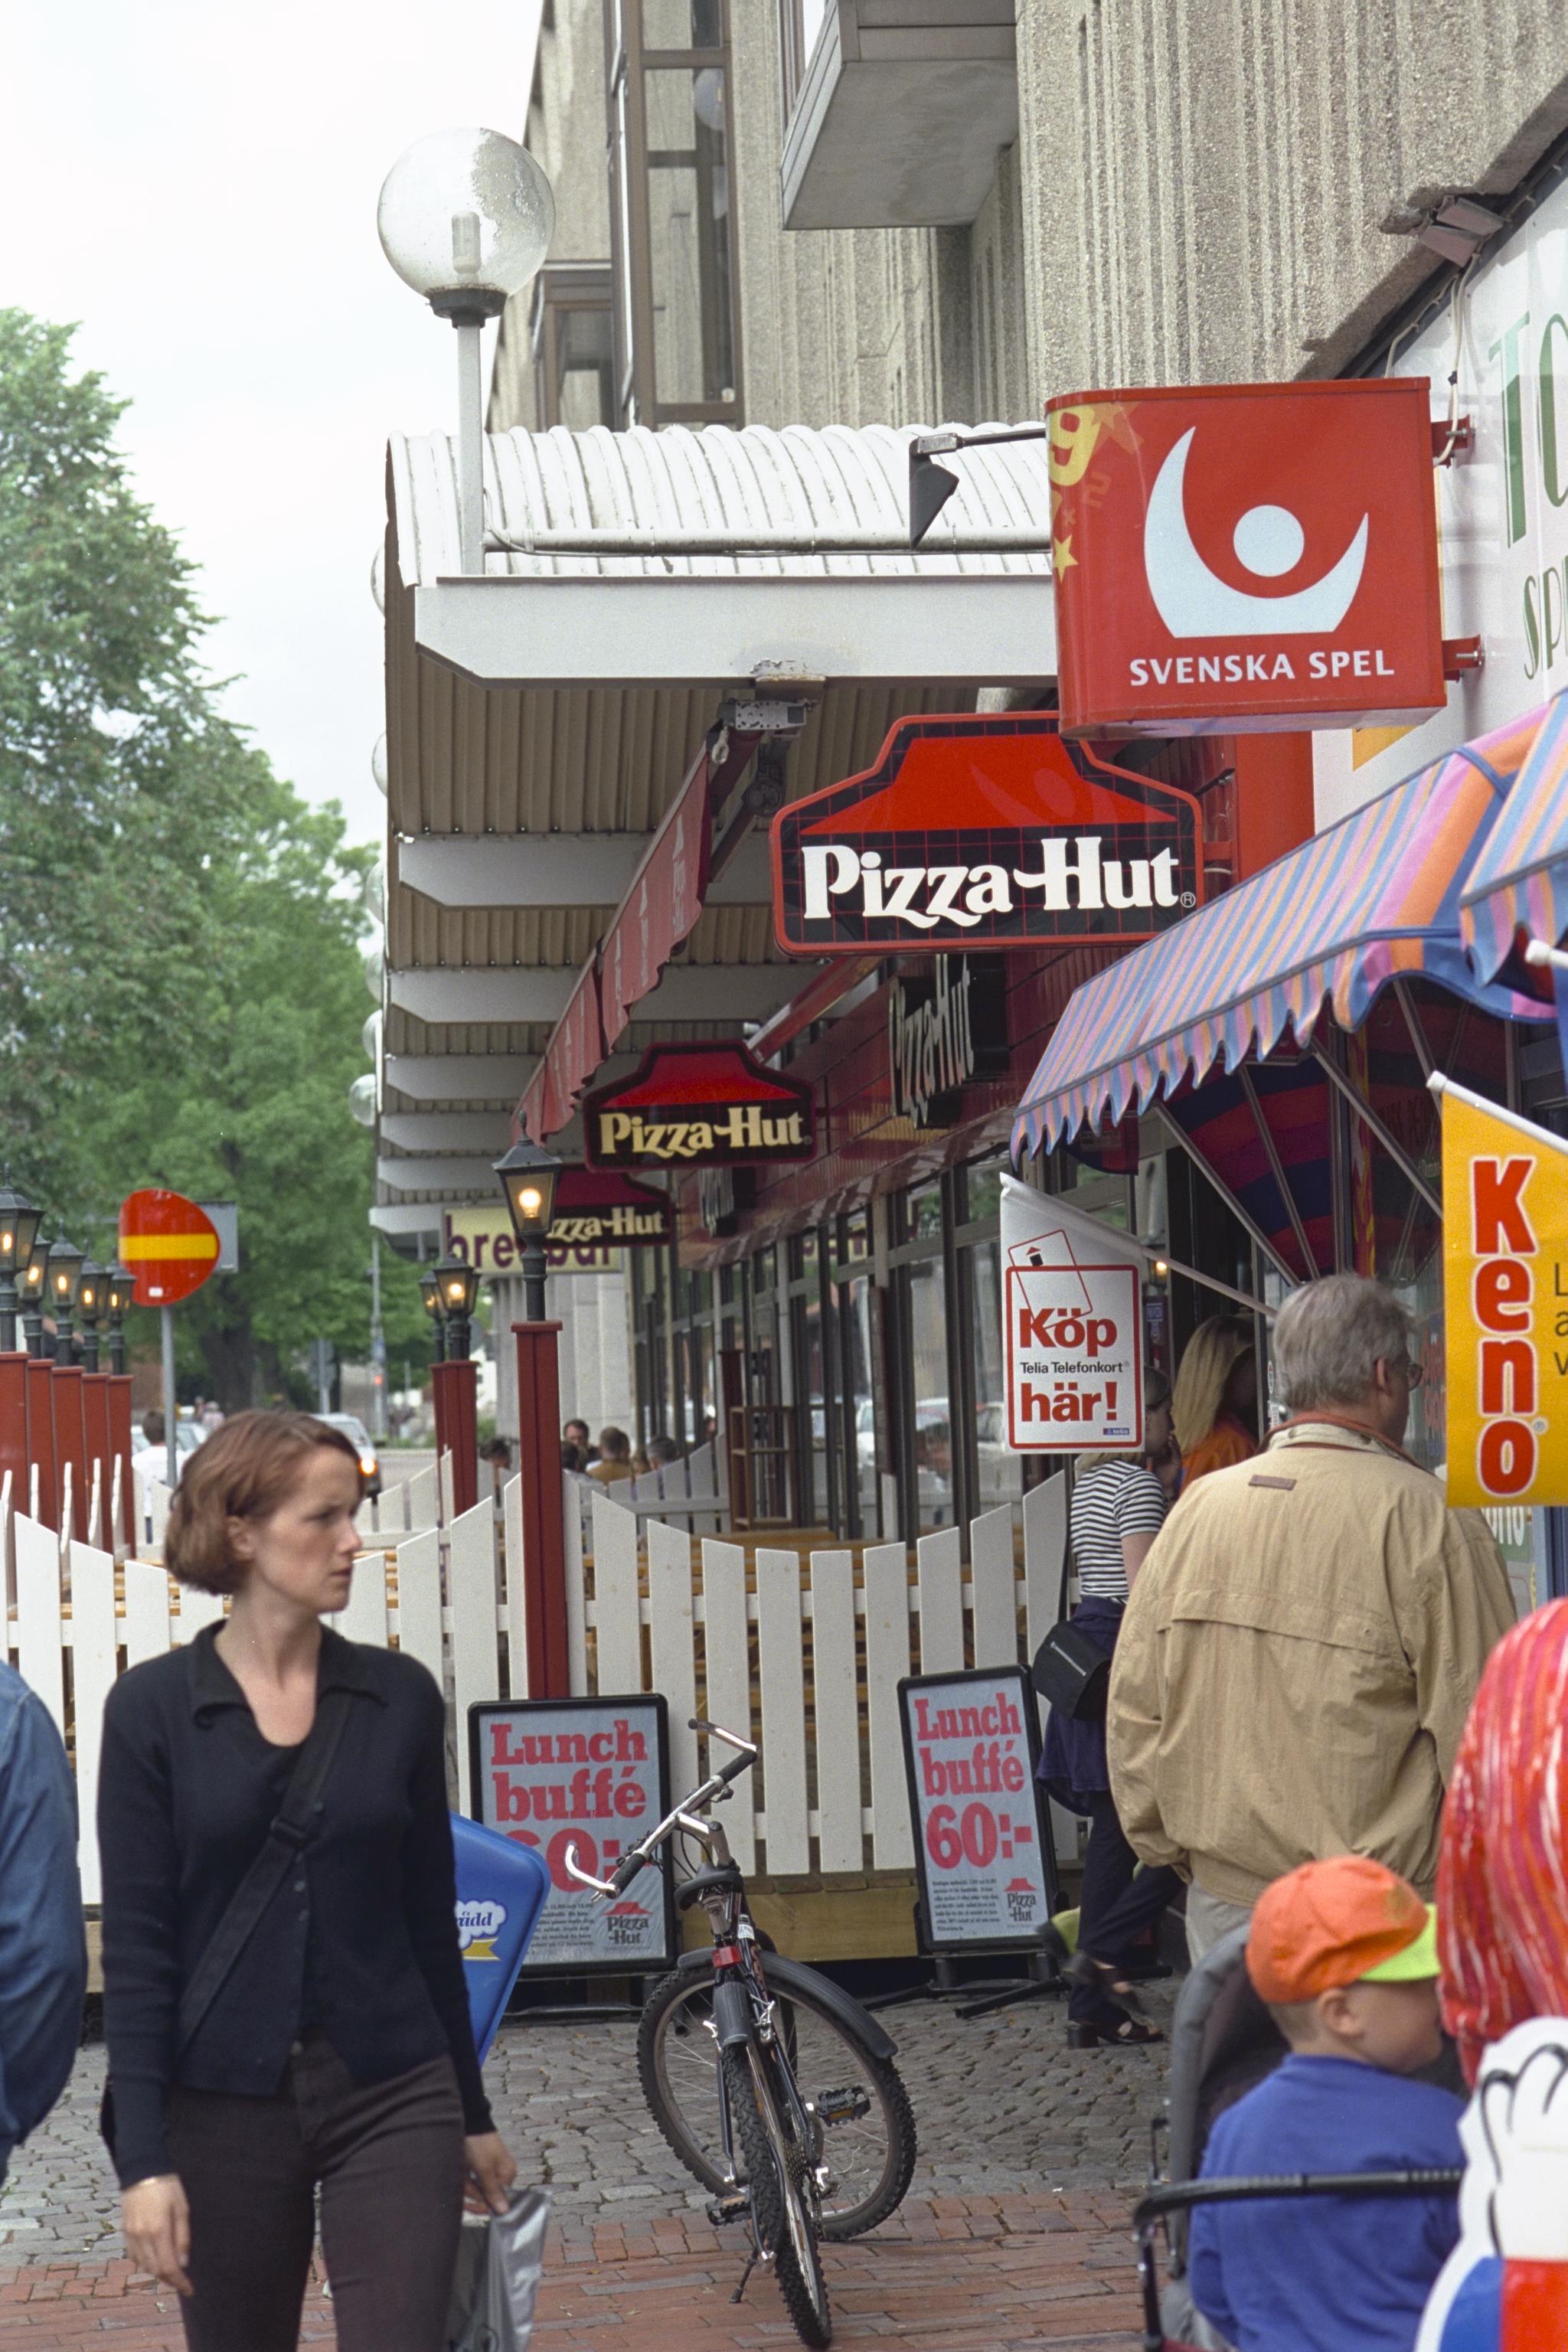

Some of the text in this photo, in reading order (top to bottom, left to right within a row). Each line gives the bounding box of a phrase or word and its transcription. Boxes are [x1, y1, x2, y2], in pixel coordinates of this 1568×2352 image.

[1129, 649, 1395, 686] SVENSKA SPEL
[802, 836, 1179, 929] Pizza Hut
[599, 1106, 804, 1158] Pizza Hut
[546, 1206, 664, 1243] zza Hut
[1019, 1307, 1118, 1357] Köp
[1472, 1158, 1537, 1496] Keno
[1020, 1361, 1123, 1374] Telia Telefonkort
[1021, 1380, 1118, 1423] här!
[913, 1692, 1022, 1742] Lunch
[490, 1719, 648, 1766] Lunch
[919, 1740, 1025, 1797] buffé
[492, 1766, 647, 1822] buffé
[926, 1802, 1033, 1870] 60:-
[505, 1828, 651, 1893] 0:
[458, 1911, 493, 1928] ädd
[606, 1916, 649, 1932] Pizza
[1007, 1892, 1037, 1909] Pizza
[1009, 1906, 1033, 1922] Hut
[608, 1929, 642, 1945] Hut
